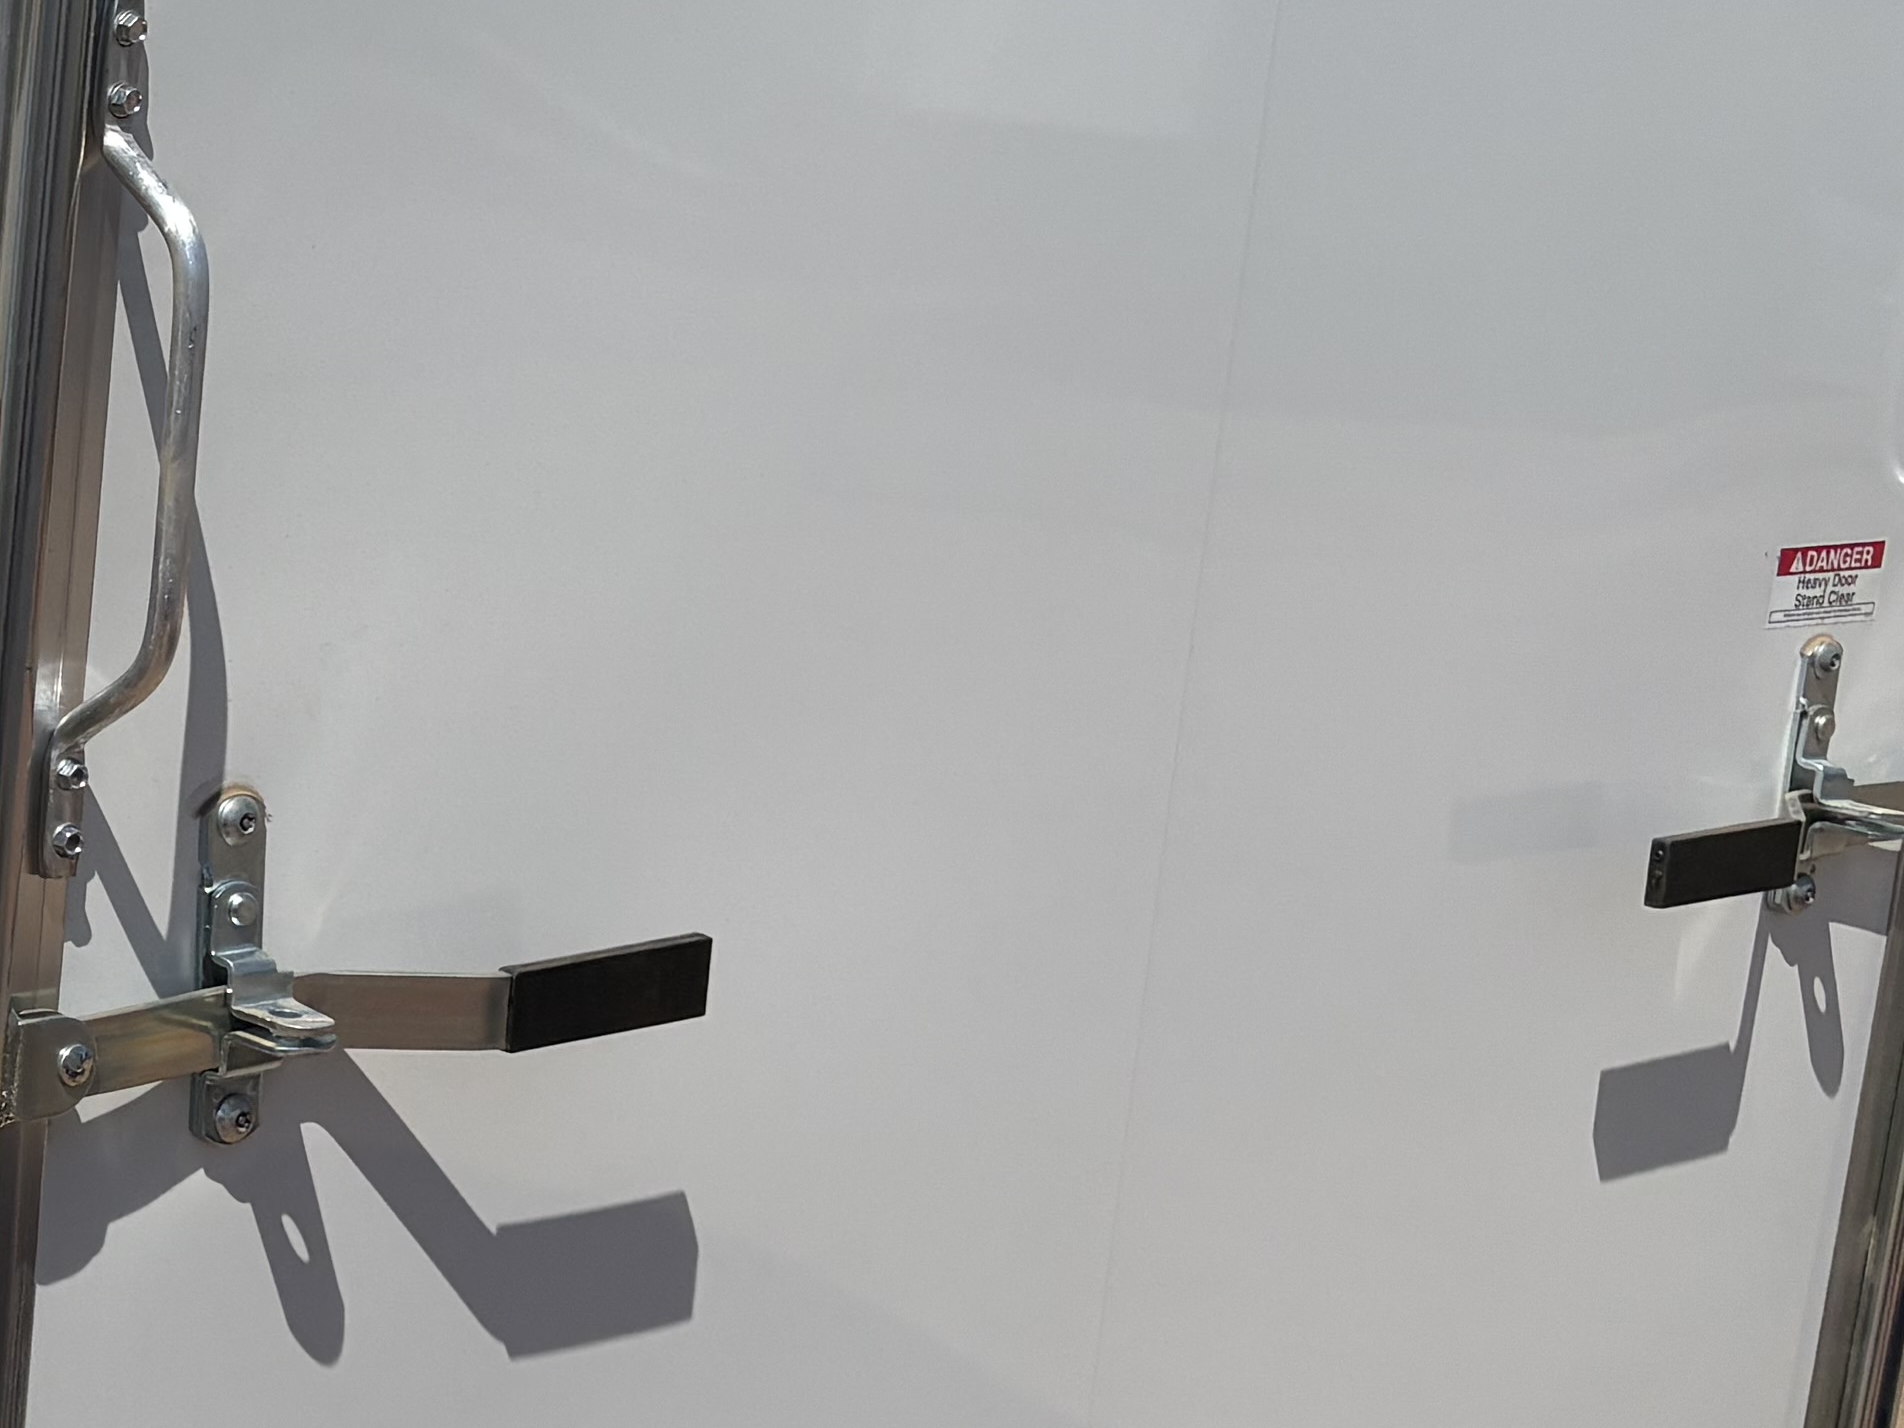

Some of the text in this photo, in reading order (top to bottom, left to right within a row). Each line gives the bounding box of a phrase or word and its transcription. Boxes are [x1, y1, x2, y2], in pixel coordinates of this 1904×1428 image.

[1805, 546, 1873, 571] DANGER
[1797, 573, 1858, 593] Heavy Door
[1794, 590, 1855, 609] Stand Clear
